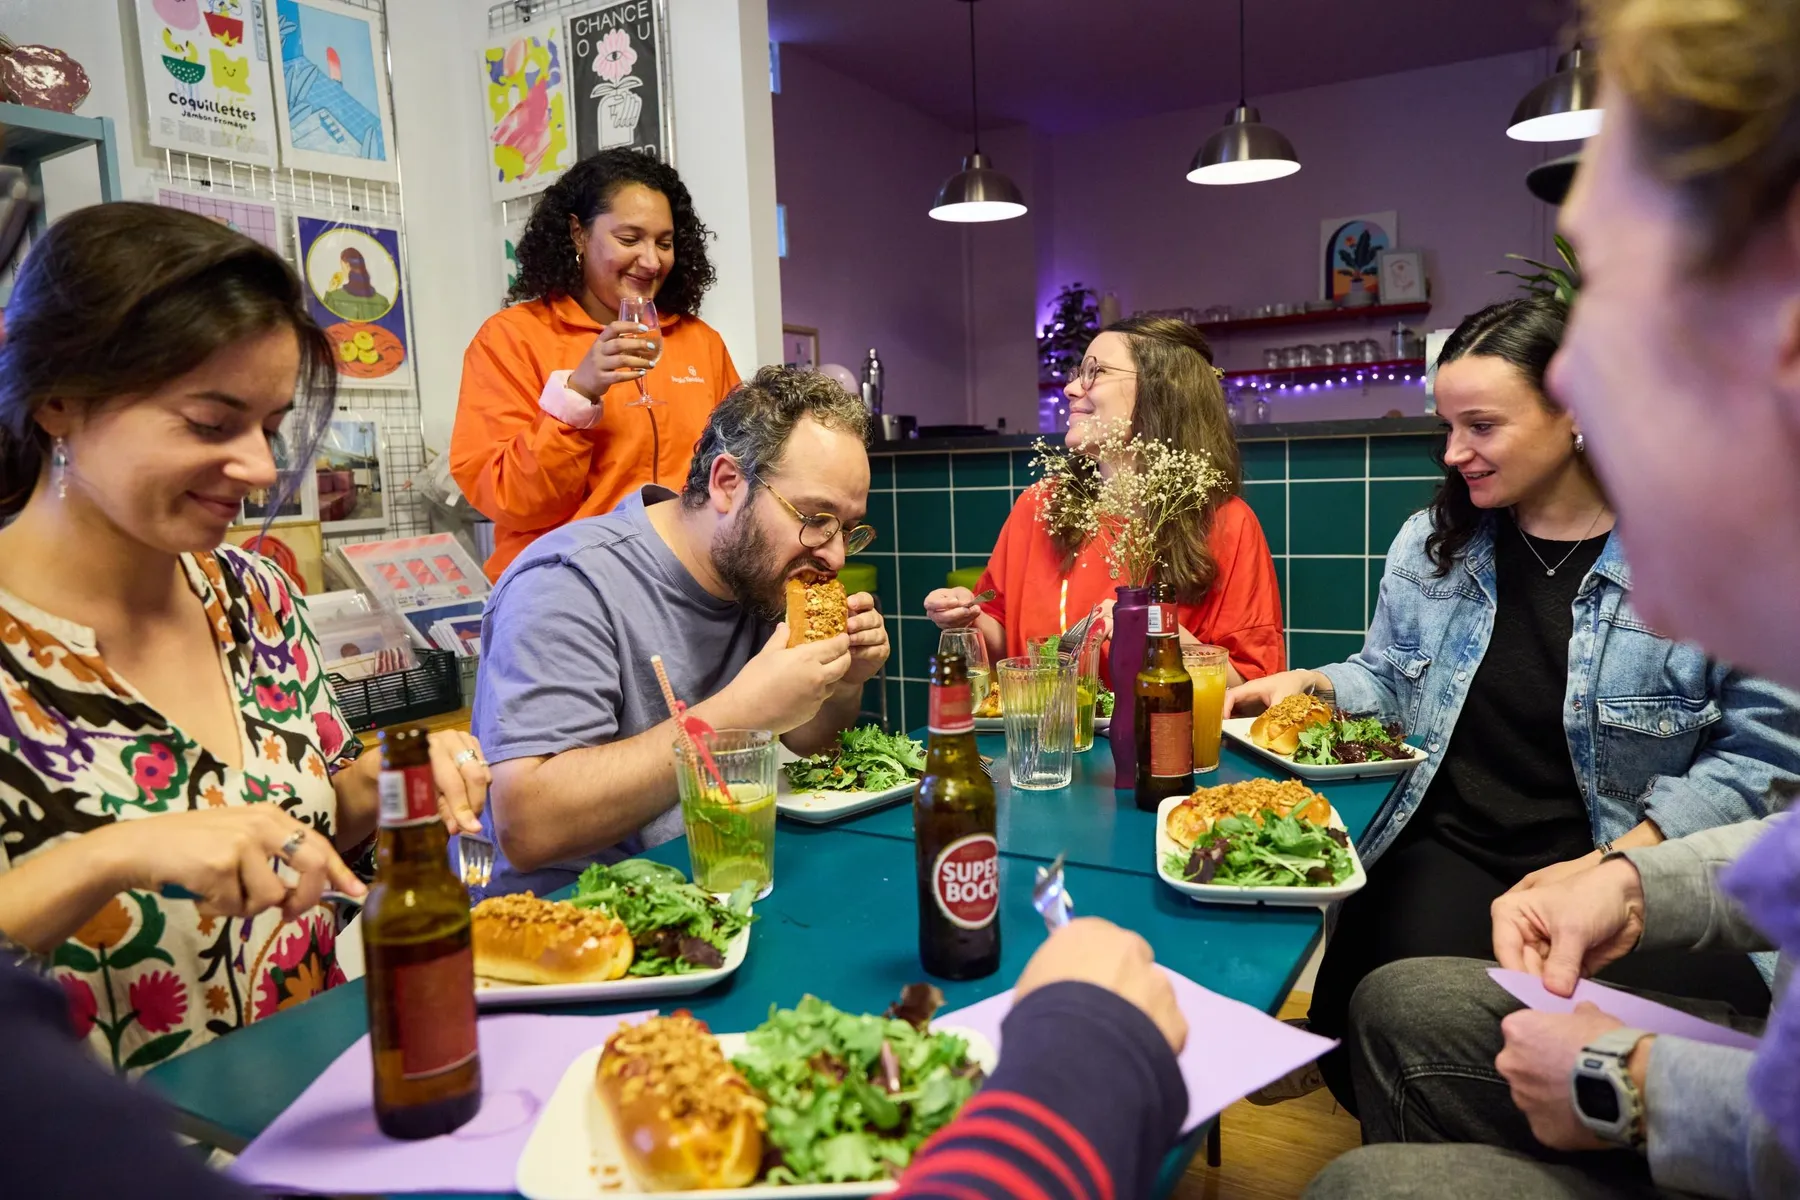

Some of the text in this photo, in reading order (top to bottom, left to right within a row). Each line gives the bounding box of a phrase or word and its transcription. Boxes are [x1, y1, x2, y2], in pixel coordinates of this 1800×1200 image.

[575, 0, 649, 36] CHANCE
[576, 21, 651, 58] O U
[168, 92, 257, 122] Coquillettes
[181, 110, 212, 123] Jambon
